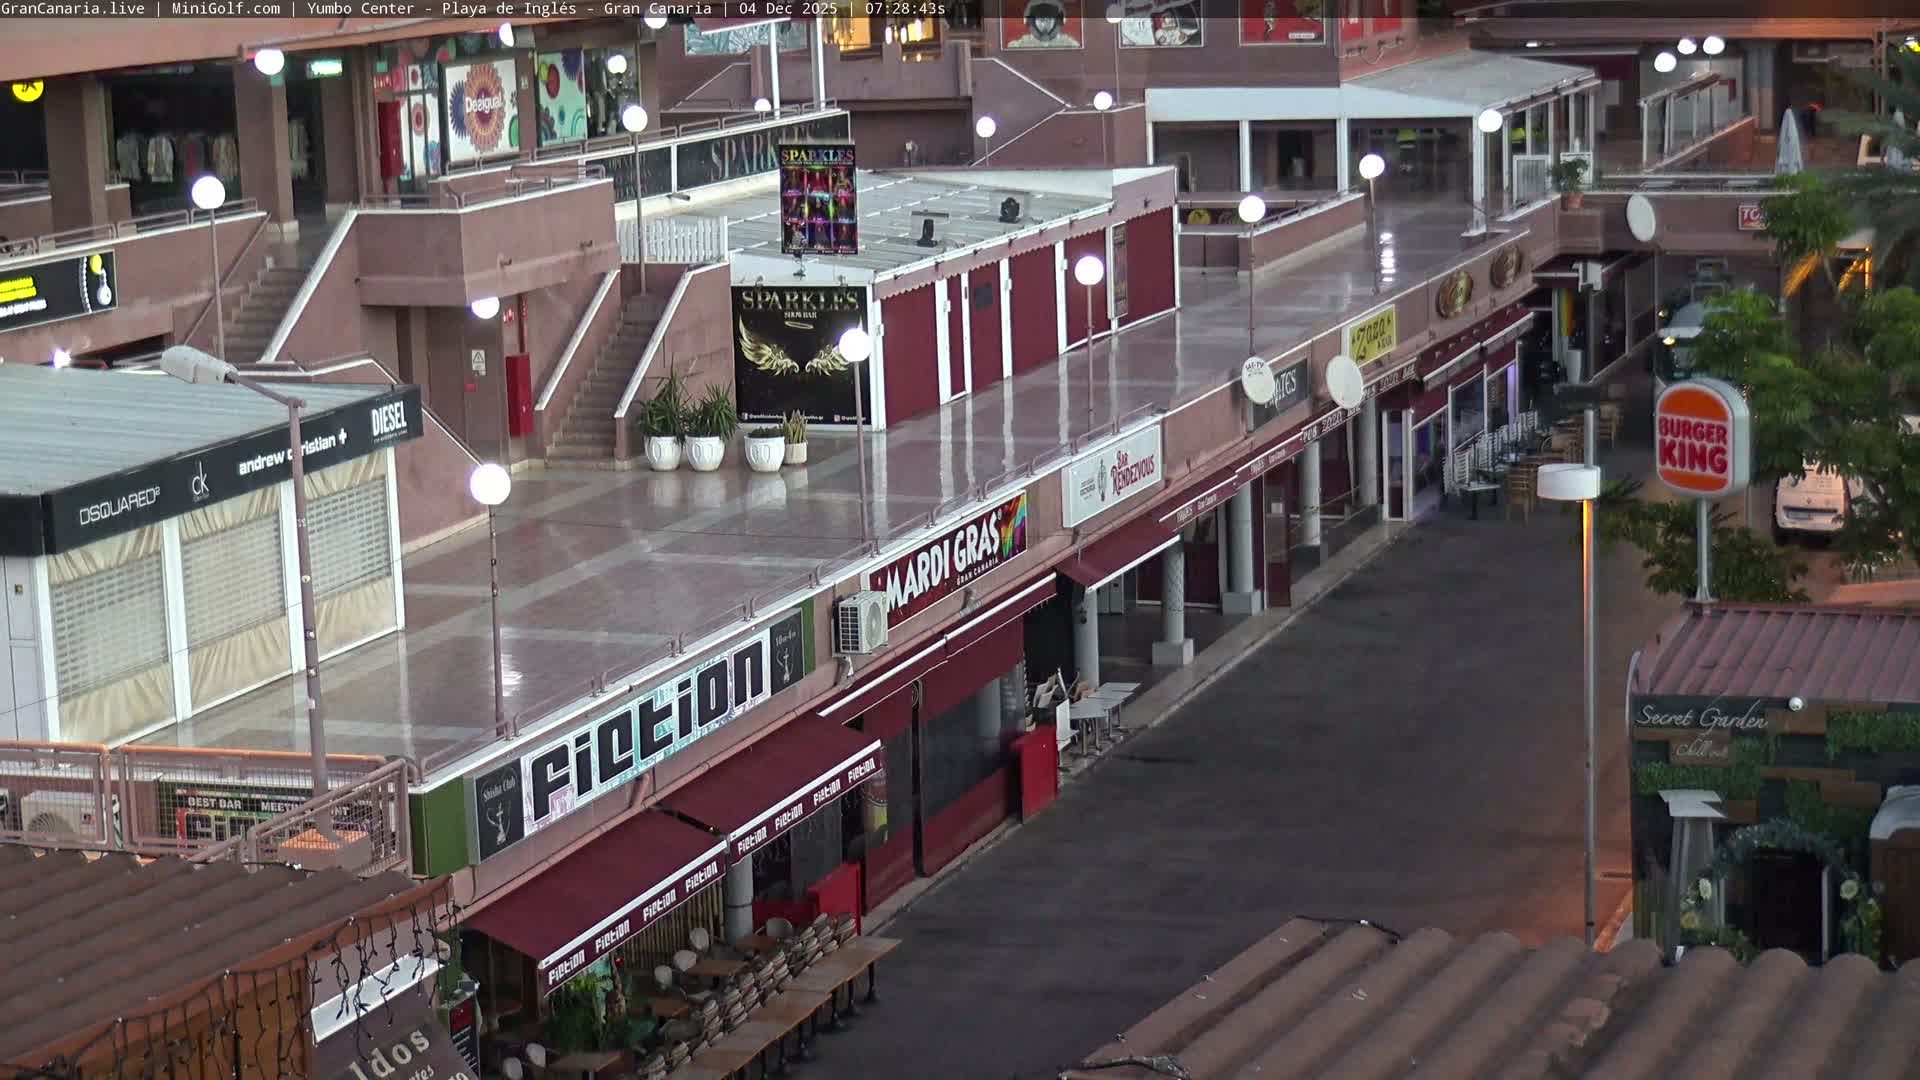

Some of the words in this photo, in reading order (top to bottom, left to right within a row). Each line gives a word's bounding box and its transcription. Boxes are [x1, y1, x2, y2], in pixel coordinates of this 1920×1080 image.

[465, 91, 502, 114] Desigual
[782, 150, 854, 161] SPARKLES
[741, 290, 859, 311] SPARKLES
[371, 400, 408, 437] DIESEL
[1658, 415, 1728, 446] BURGER
[239, 450, 286, 476] andrew
[287, 434, 337, 461] cristian
[1658, 438, 1729, 475] KING
[886, 539, 950, 614] MARDI
[953, 510, 1001, 573] GRAS
[973, 556, 999, 576] CANARIA
[1636, 704, 1694, 727] Secret
[1699, 699, 1769, 736] Garden
[220, 799, 242, 810] BAR
